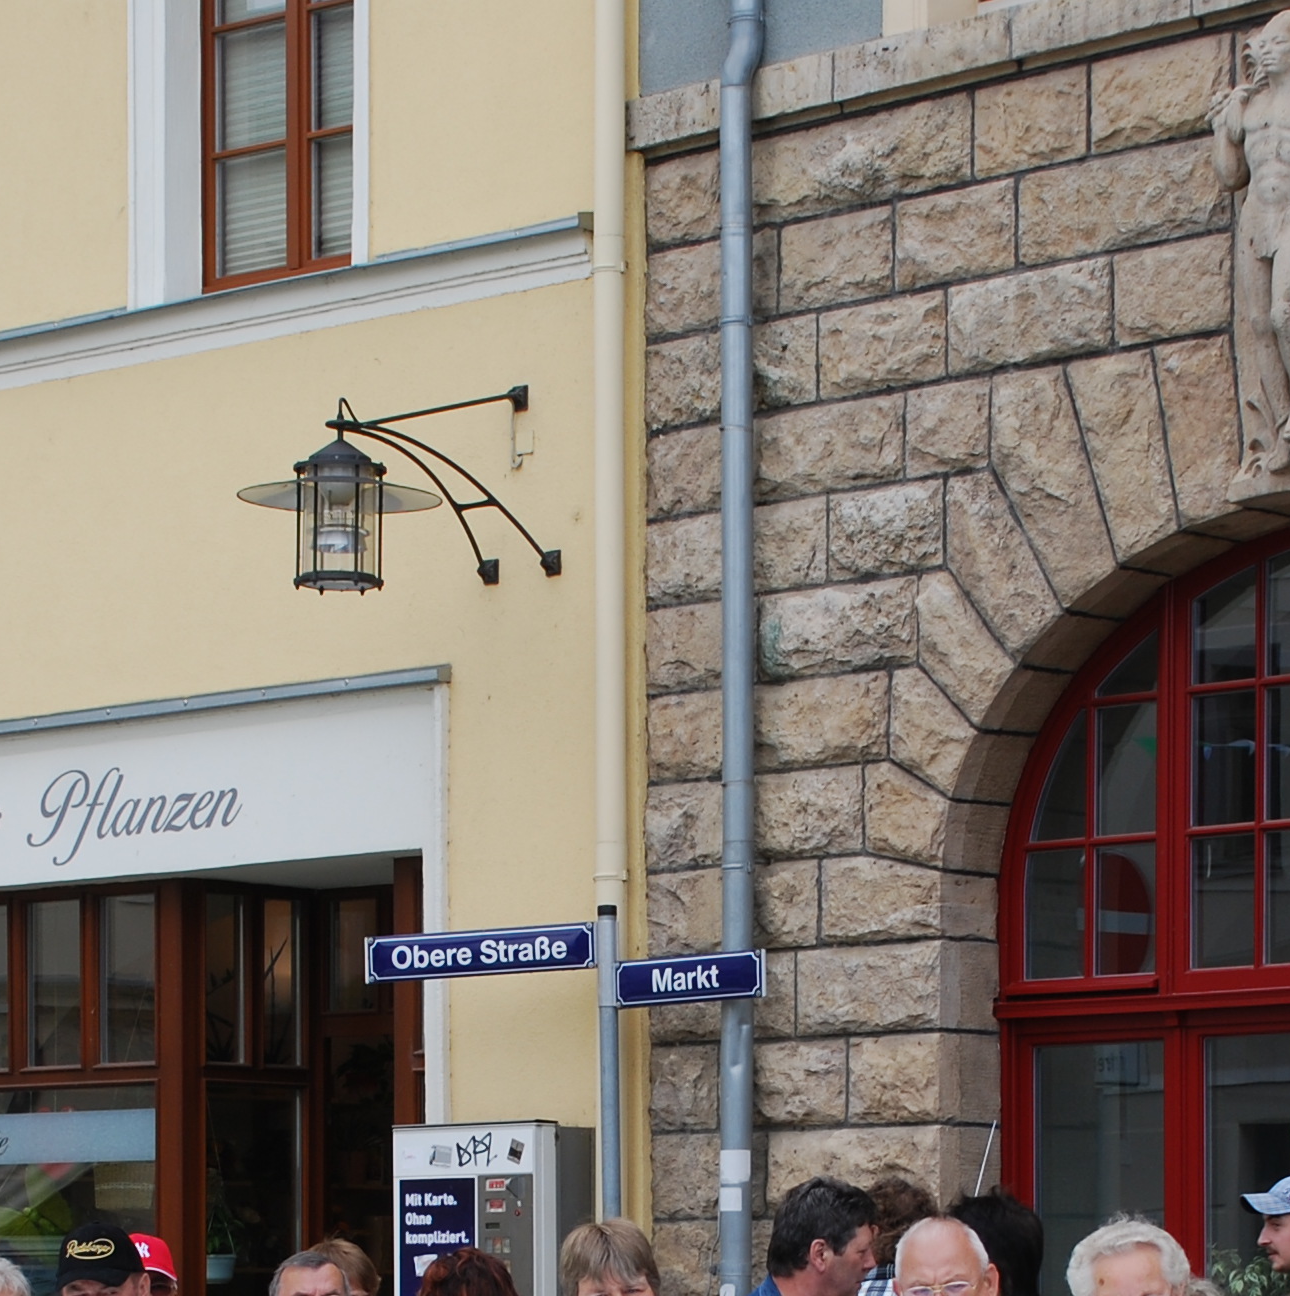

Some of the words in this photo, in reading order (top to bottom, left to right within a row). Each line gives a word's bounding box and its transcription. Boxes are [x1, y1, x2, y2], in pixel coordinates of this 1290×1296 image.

[26, 766, 242, 866] Pflanzen
[391, 945, 472, 970] Obere
[479, 935, 568, 965] Straße
[651, 964, 720, 993] Markt
[405, 1193, 422, 1207] Mit
[424, 1193, 457, 1206] Karte.
[405, 1212, 432, 1226] Ohne
[405, 1230, 469, 1247] kompliziert.
